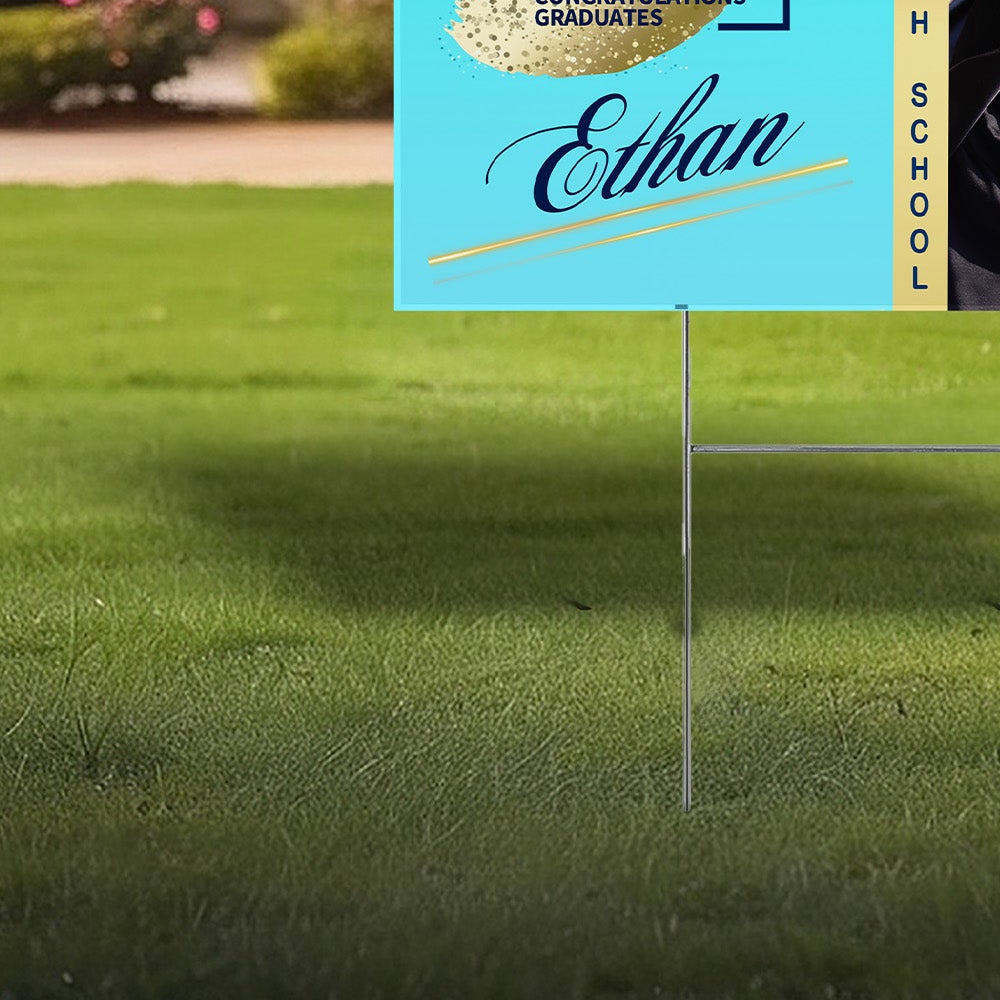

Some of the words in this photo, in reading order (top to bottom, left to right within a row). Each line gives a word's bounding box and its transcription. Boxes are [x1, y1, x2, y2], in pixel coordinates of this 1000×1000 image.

[534, 8, 664, 27] GRADUATES
[486, 73, 805, 214] Ethan
[909, 82, 929, 290] SCHOOL
